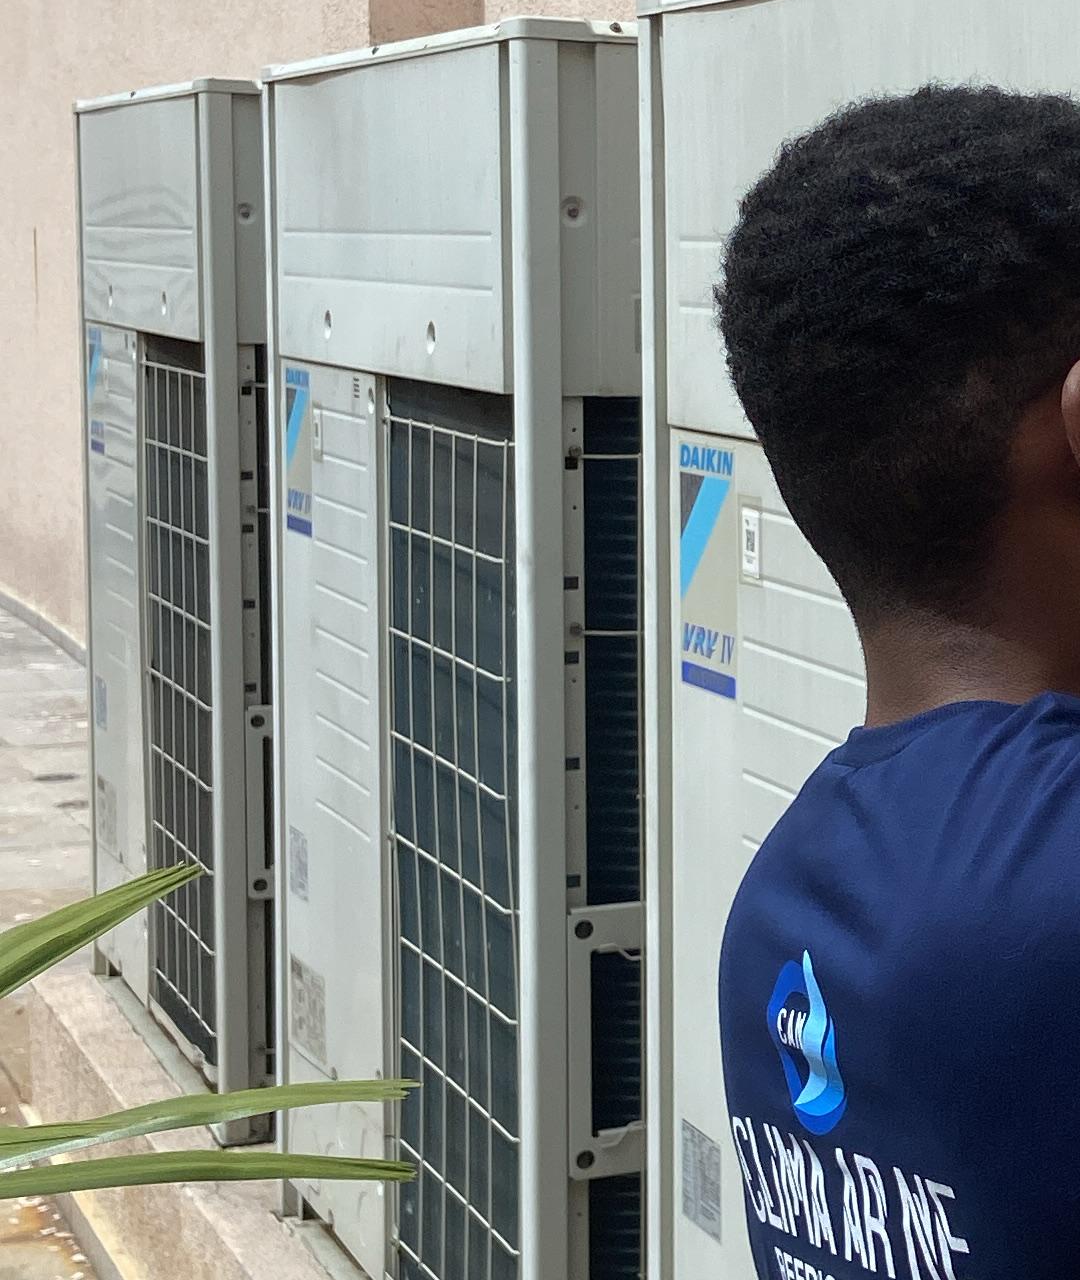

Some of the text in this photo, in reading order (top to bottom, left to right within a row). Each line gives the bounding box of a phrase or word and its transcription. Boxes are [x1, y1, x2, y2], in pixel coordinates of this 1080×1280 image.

[680, 444, 733, 476] DAIKIN
[683, 623, 735, 665] VRV IV
[835, 1147, 896, 1280] AR
